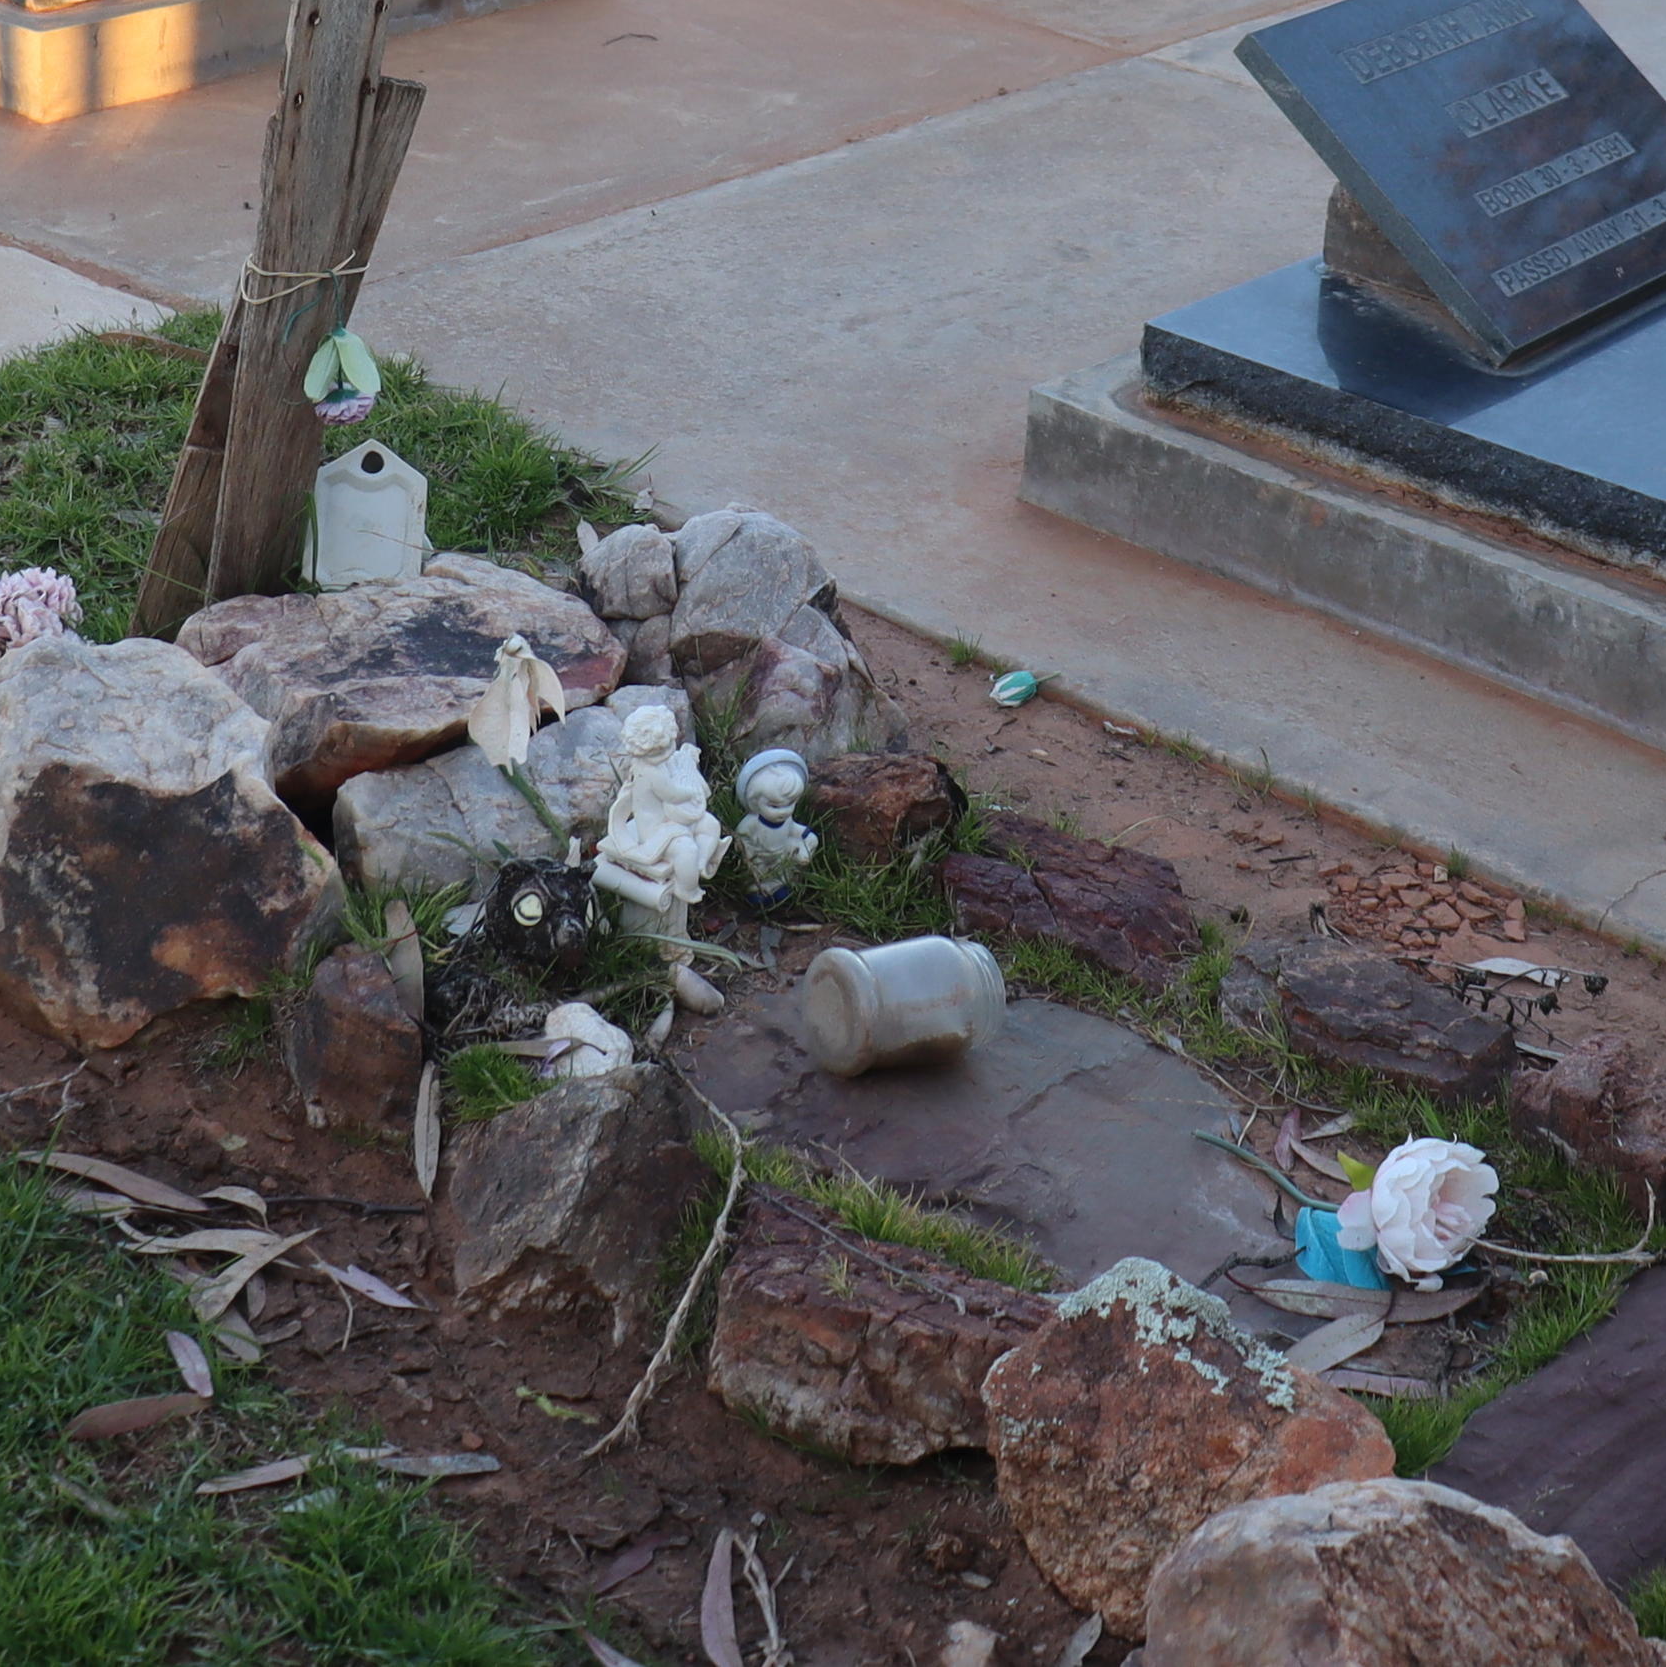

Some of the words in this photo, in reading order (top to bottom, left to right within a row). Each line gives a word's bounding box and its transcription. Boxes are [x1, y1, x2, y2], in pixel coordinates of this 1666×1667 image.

[1343, 16, 1472, 78] DEBORAH
[1453, 71, 1559, 130] CLARKE
[1481, 175, 1535, 214] BORN
[1498, 245, 1572, 293] PASSED
[1573, 220, 1625, 258] AWAY
